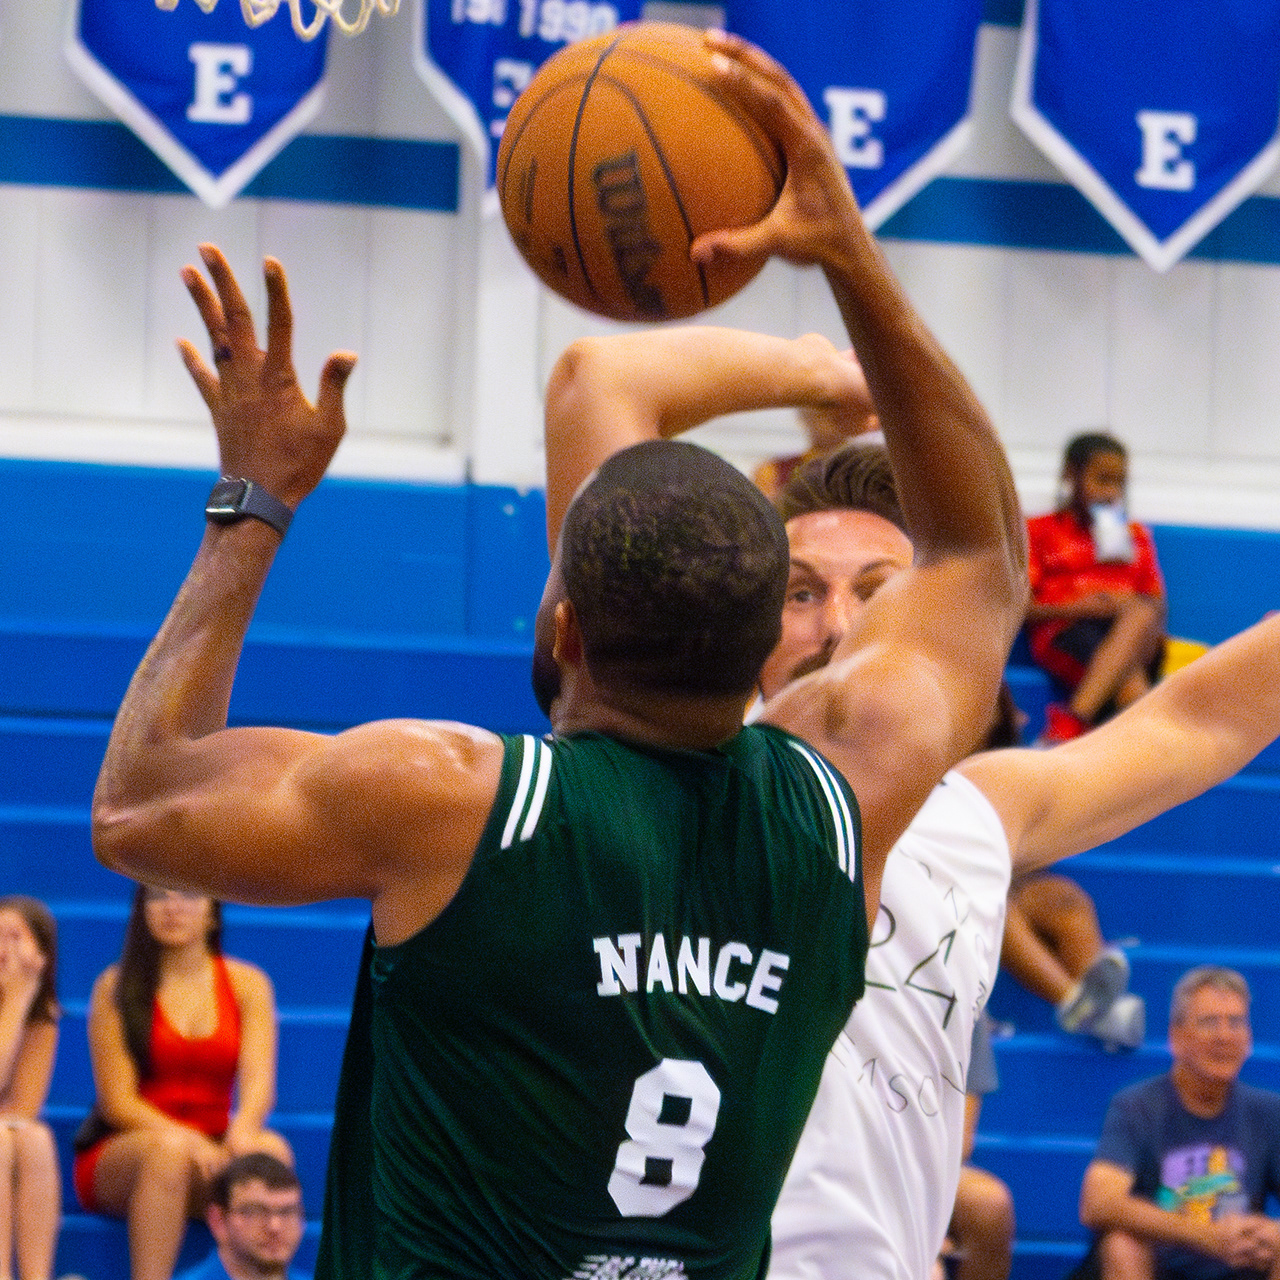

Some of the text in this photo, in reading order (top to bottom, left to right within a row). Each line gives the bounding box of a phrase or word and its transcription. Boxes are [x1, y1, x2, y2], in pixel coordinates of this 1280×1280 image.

[187, 43, 251, 124] E
[824, 87, 886, 169] E
[1136, 111, 1196, 191] E
[593, 932, 790, 1015] NANCE
[607, 1057, 721, 1217] 8
